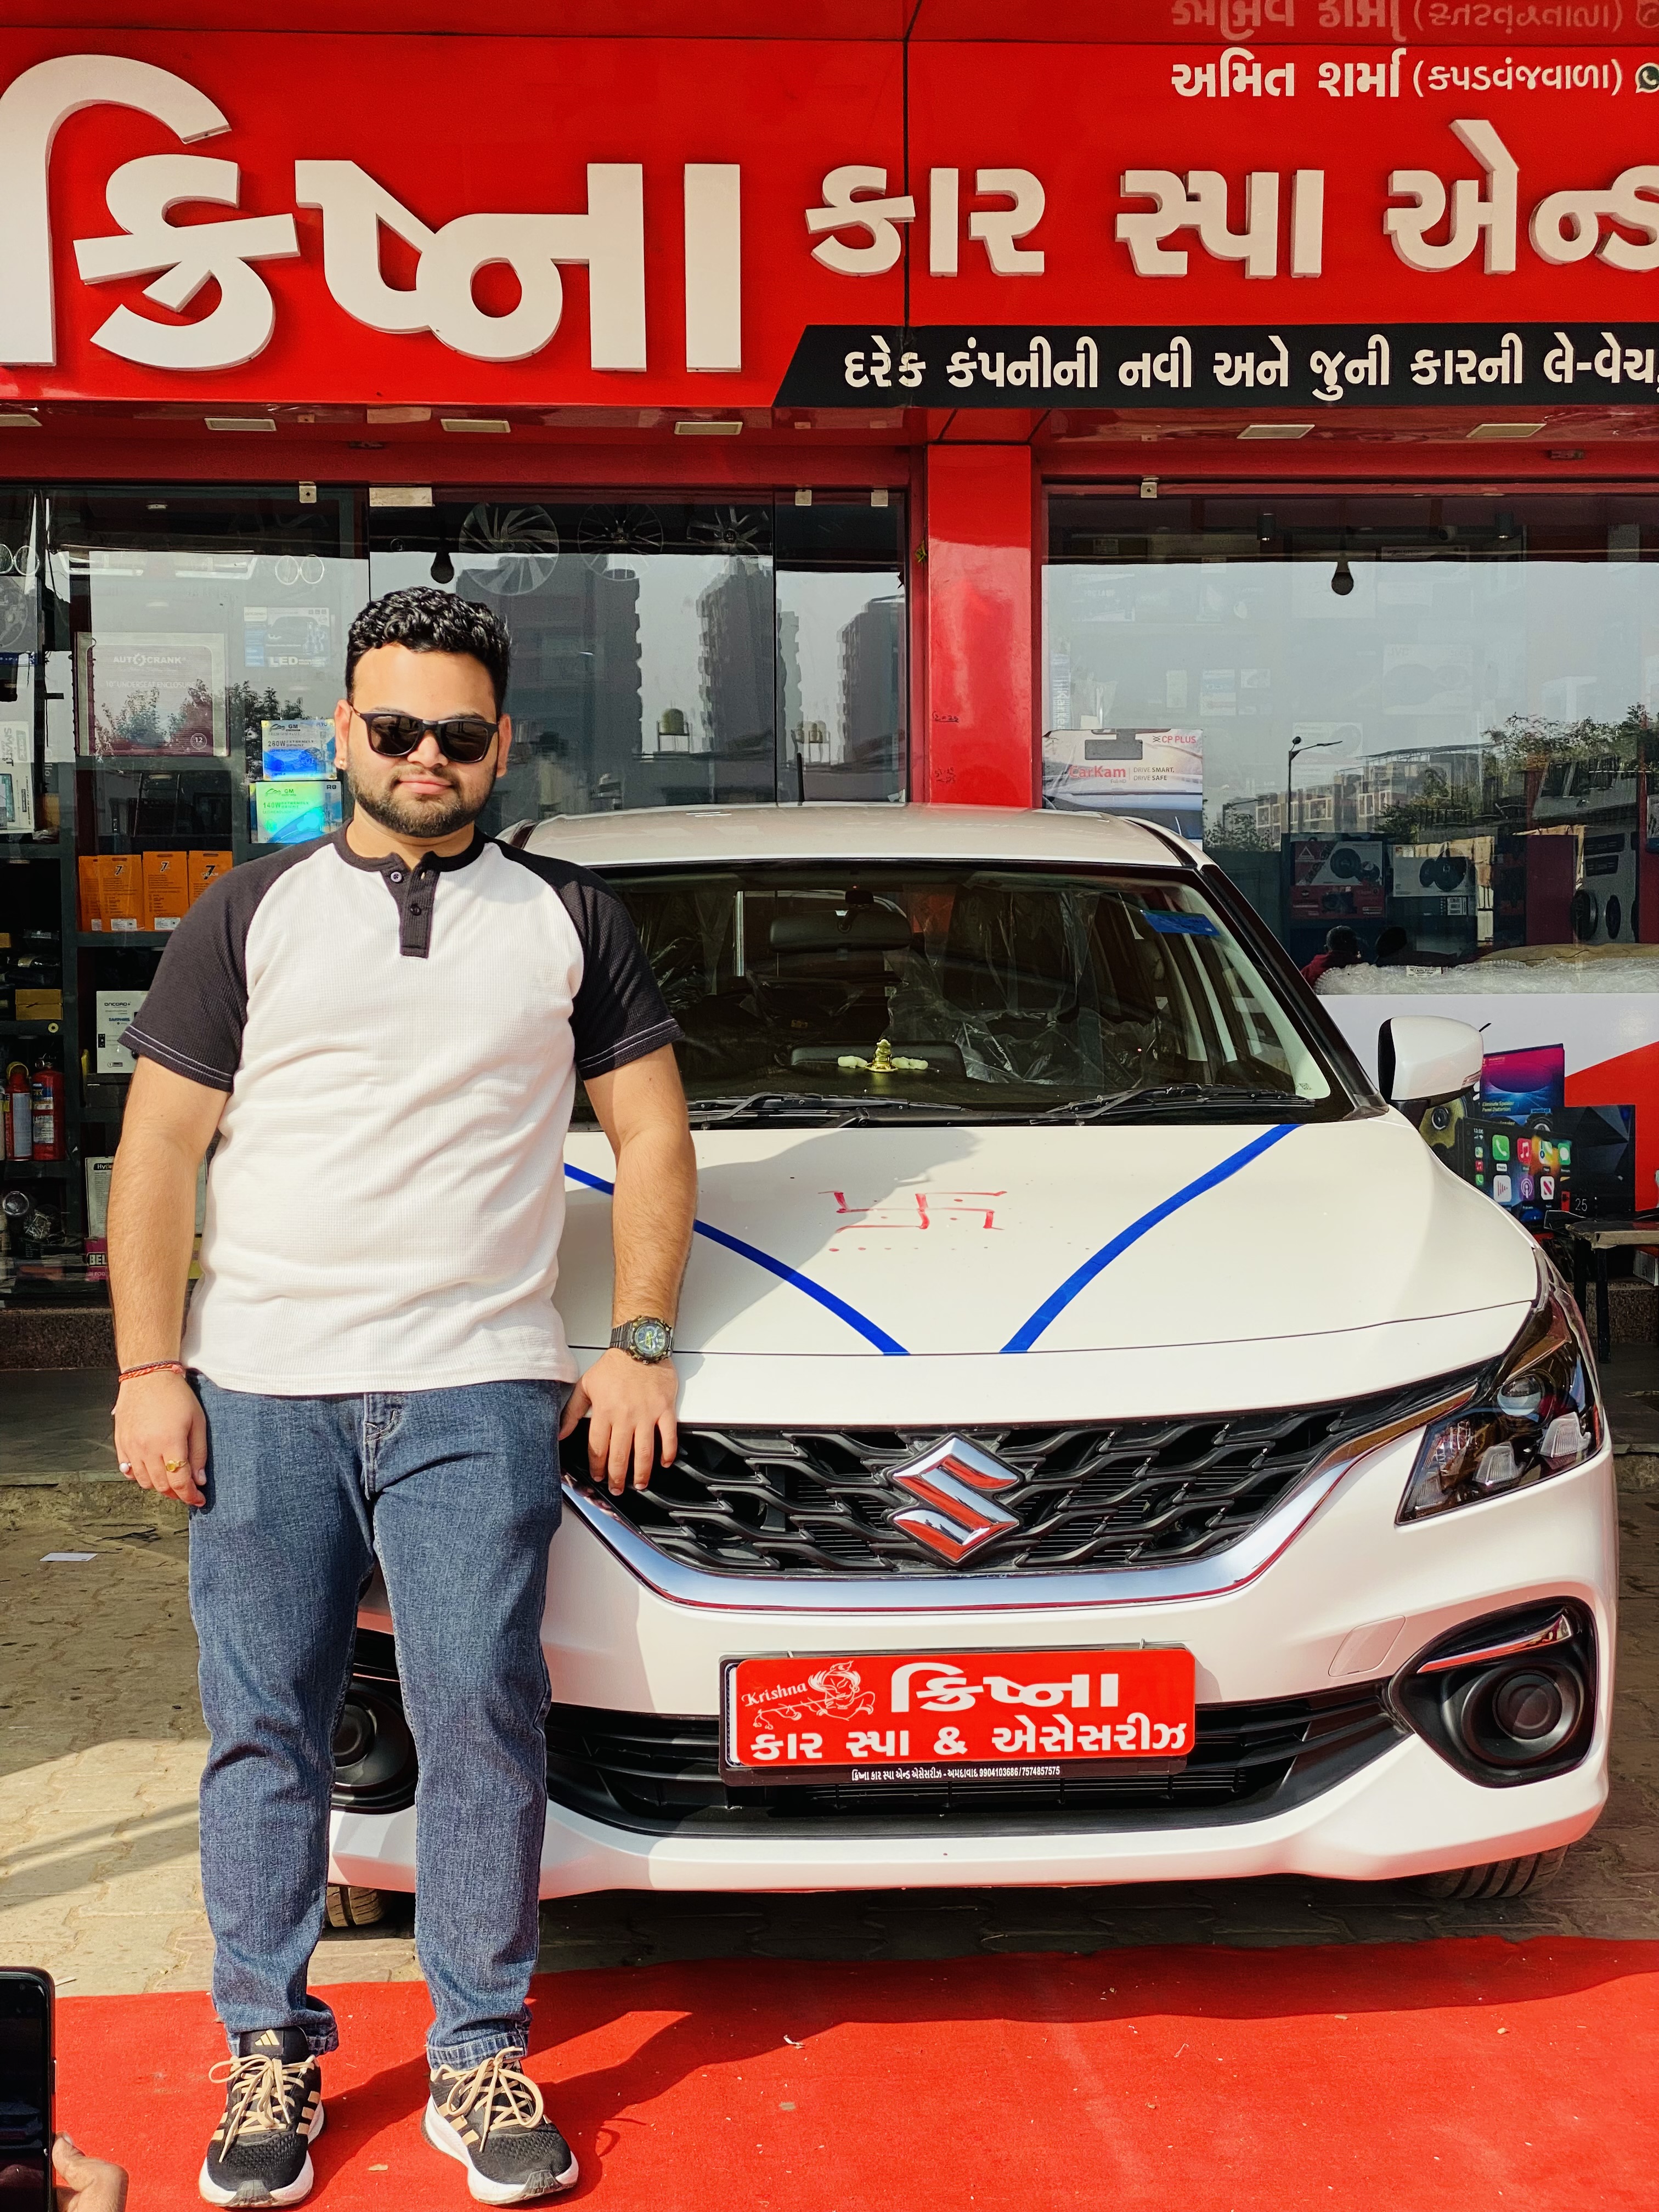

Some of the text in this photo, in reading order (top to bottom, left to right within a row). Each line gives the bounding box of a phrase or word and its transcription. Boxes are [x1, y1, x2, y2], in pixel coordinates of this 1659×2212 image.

[1171, 47, 1622, 98] અમિત શર્મા (કપડવંજવાળા)
[806, 166, 1046, 276] કાર
[1116, 170, 1324, 278] સ્પા
[844, 332, 1659, 402] દરેક કંપનીની નવી અને જુની કારની લે-વેચ
[270, 657, 298, 665] LED
[1069, 765, 1126, 778] CarKam
[1575, 1198, 1588, 1211] 25
[742, 1681, 808, 1708] Krishna
[891, 1662, 1119, 1713] ક્રિષ્ના
[750, 1712, 1187, 1760] કાર સ્પા & એસેસરીઝ
[871, 1771, 882, 1780] કાર
[883, 1770, 895, 1780] સ્પા
[895, 1768, 911, 1780] એન્ડ
[947, 1768, 979, 1779] અમદાવાદ
